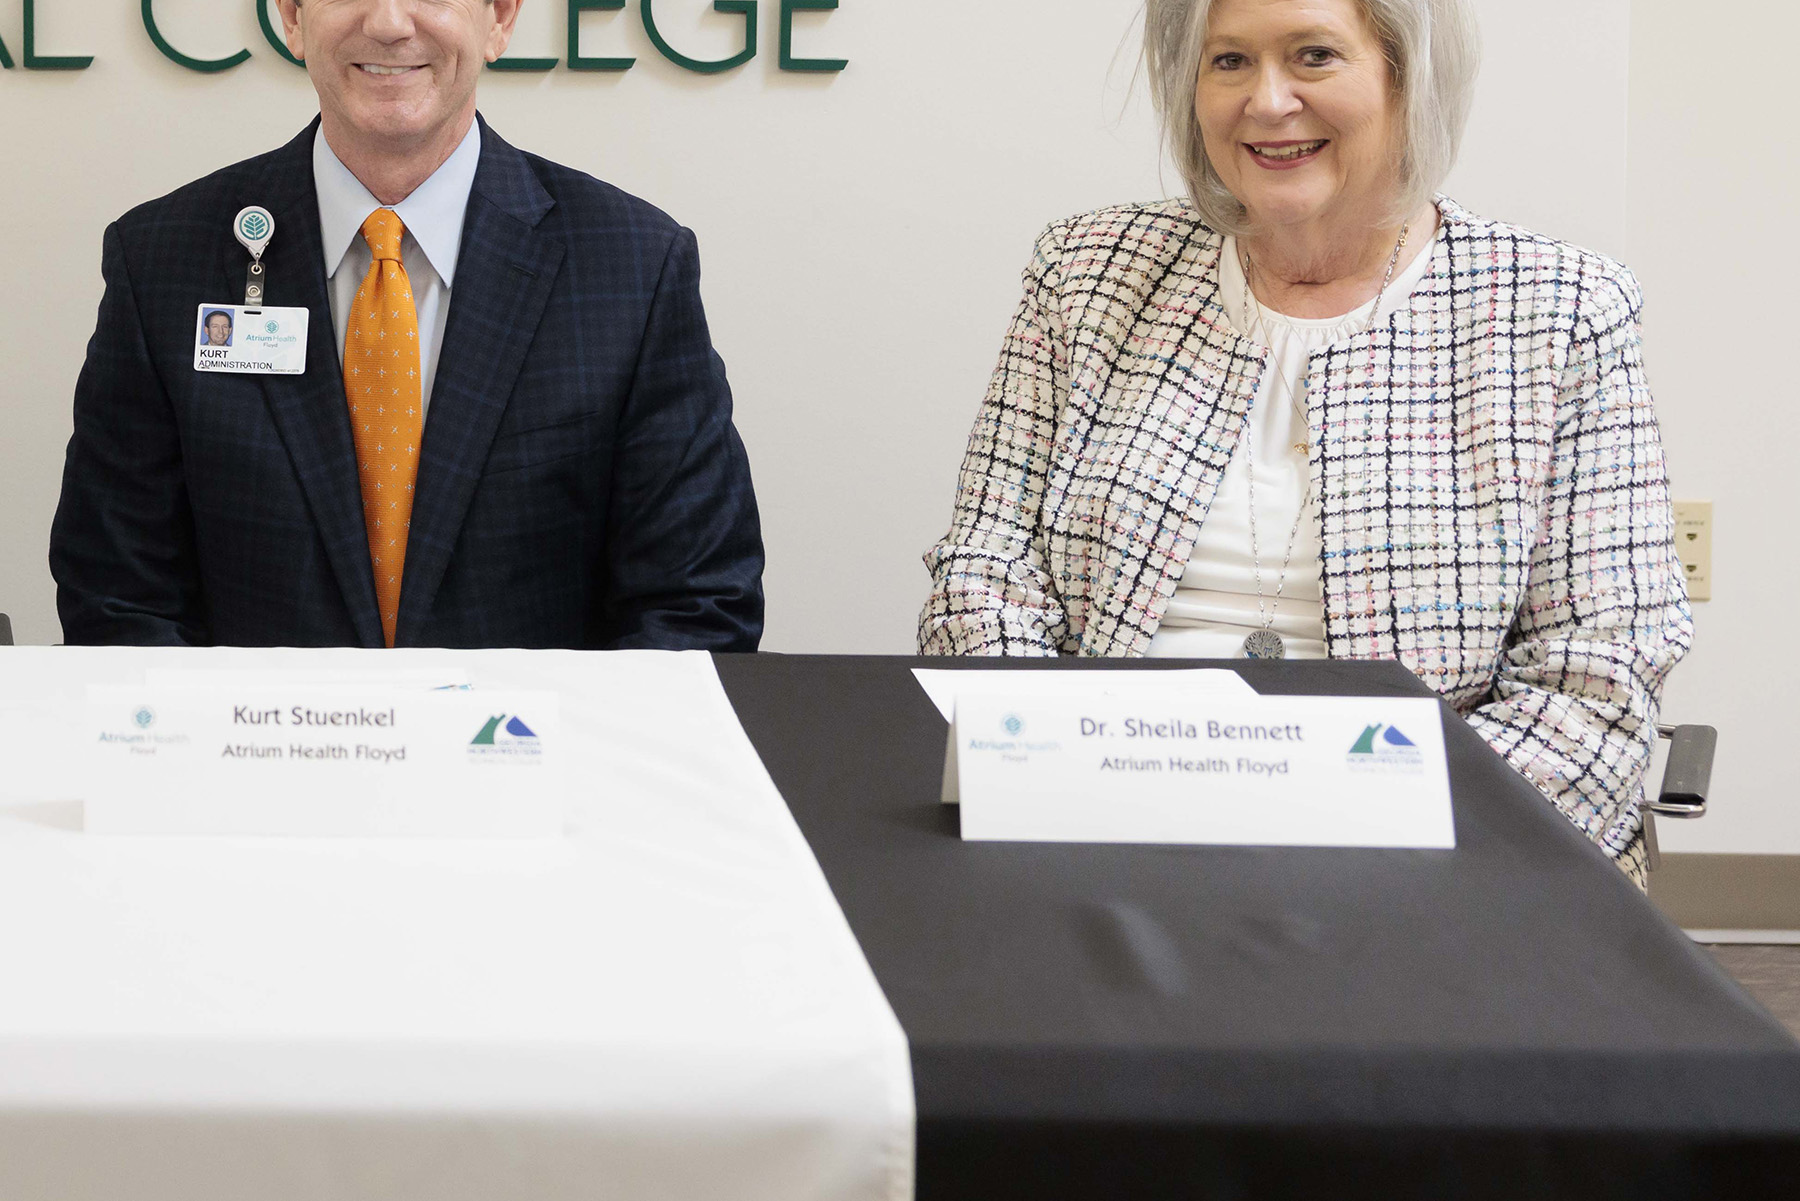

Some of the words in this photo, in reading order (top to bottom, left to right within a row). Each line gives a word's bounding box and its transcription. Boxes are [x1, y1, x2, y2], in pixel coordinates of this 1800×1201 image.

[246, 334, 272, 342] Atrium
[200, 349, 229, 359] KURT
[198, 360, 273, 370] ADMINISTRATION
[233, 705, 281, 725] Kurt
[291, 706, 395, 727] Stuenkel
[1080, 717, 1114, 737] Dr.
[1124, 717, 1198, 739] Sheila
[1206, 719, 1304, 741] Bennett
[98, 731, 145, 744] Atrium
[221, 744, 283, 759] Atrium
[289, 744, 349, 760] Health
[355, 745, 406, 763] Floyd
[1100, 756, 1162, 772] Atrium
[1168, 757, 1230, 773] Health
[1236, 757, 1289, 776] Floyd
